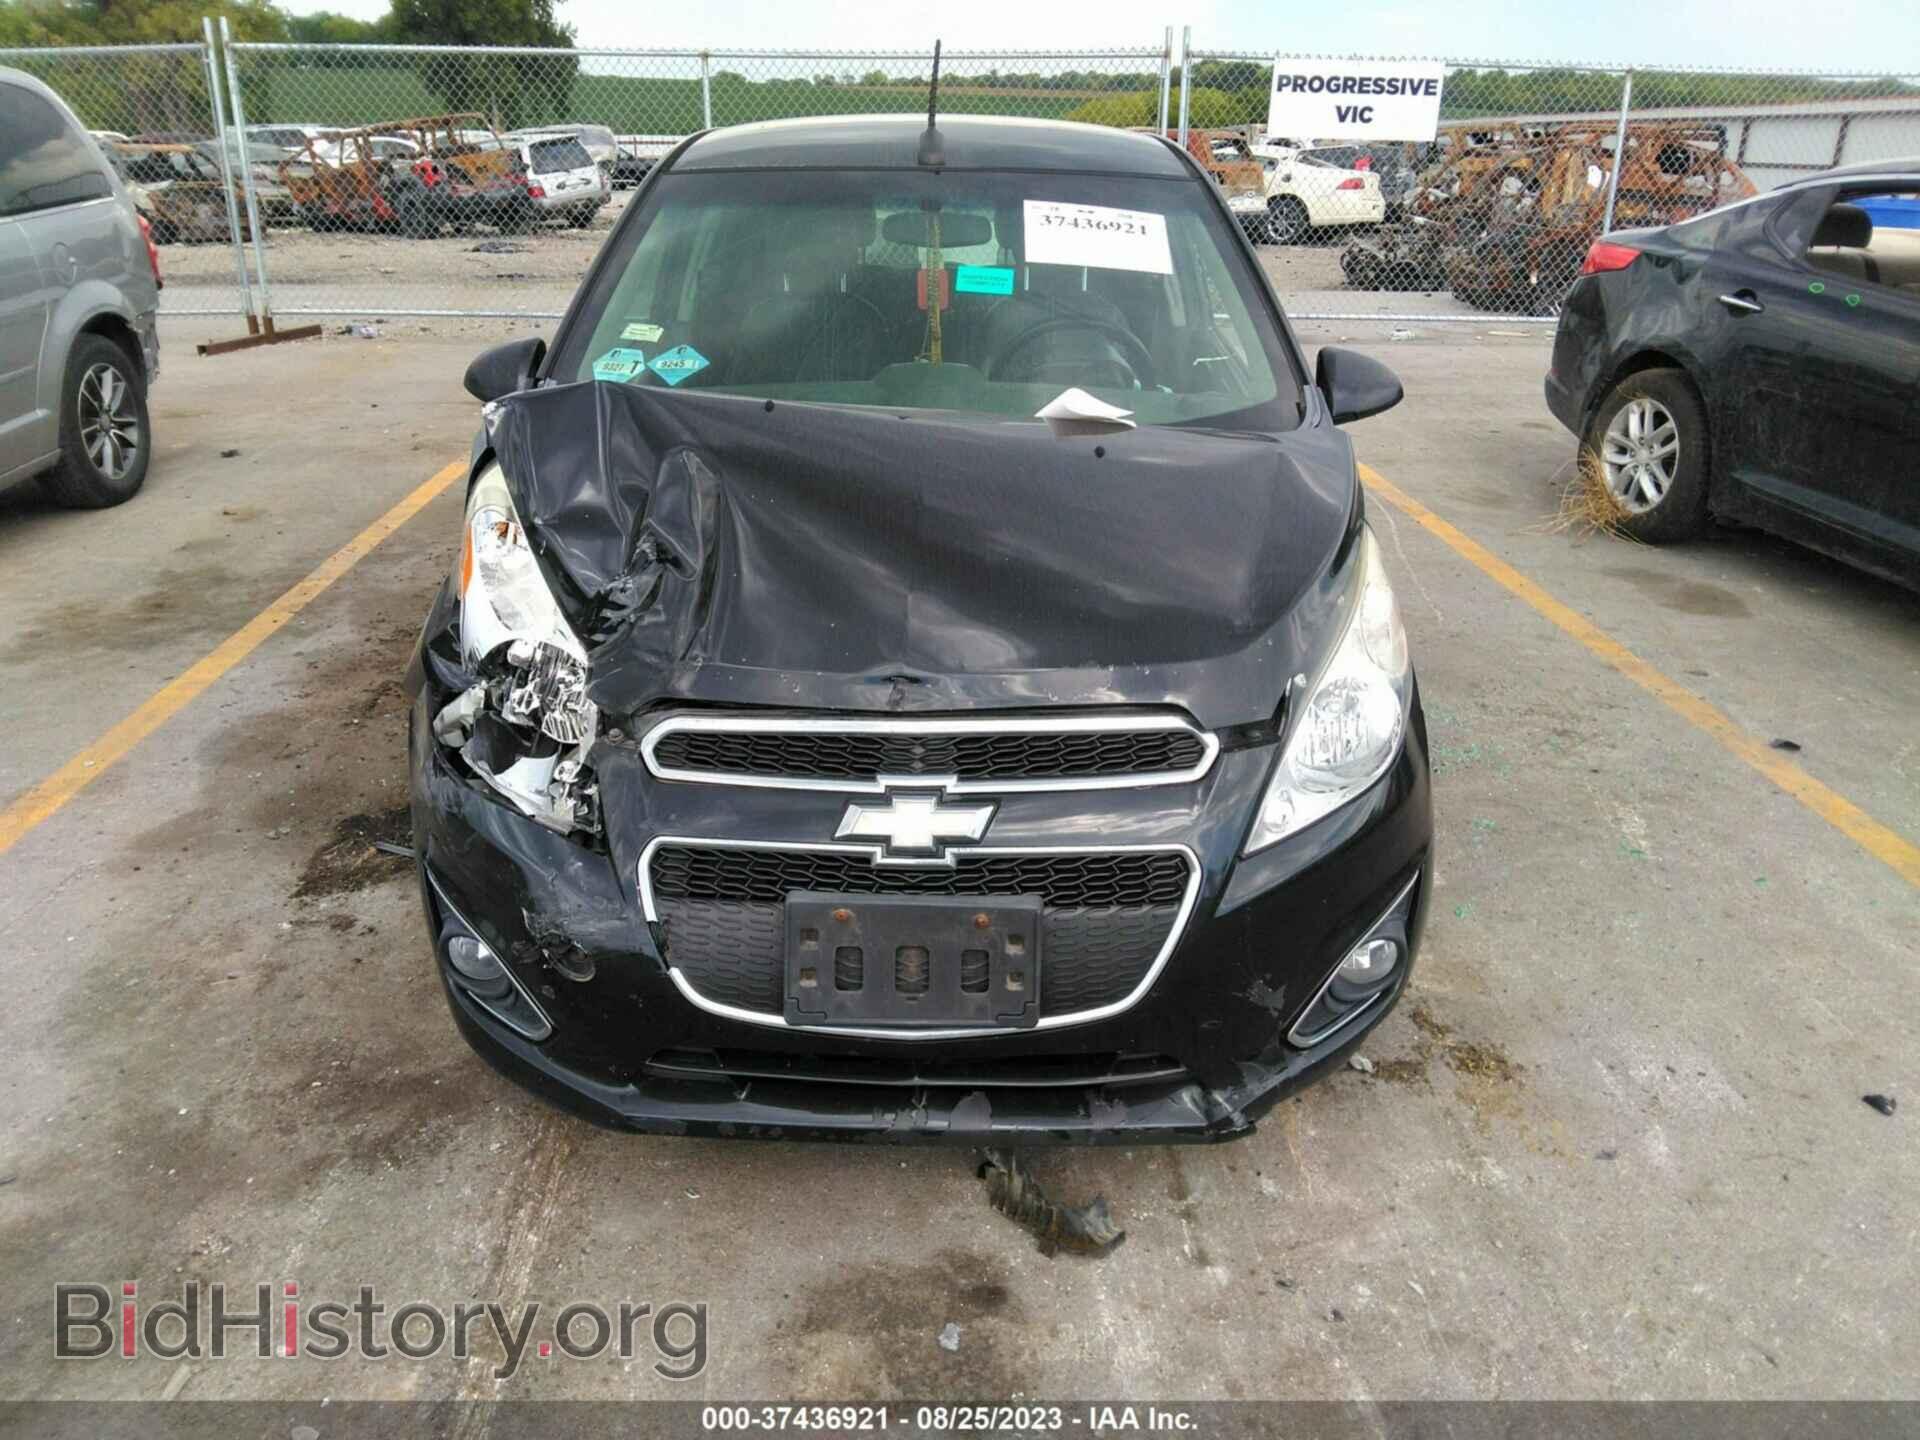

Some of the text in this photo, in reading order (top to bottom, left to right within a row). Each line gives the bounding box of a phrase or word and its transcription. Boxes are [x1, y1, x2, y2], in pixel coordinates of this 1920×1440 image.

[1276, 74, 1439, 96] PROGRESSIVE
[1335, 105, 1374, 124] VIC
[1039, 214, 1147, 236] 37436921
